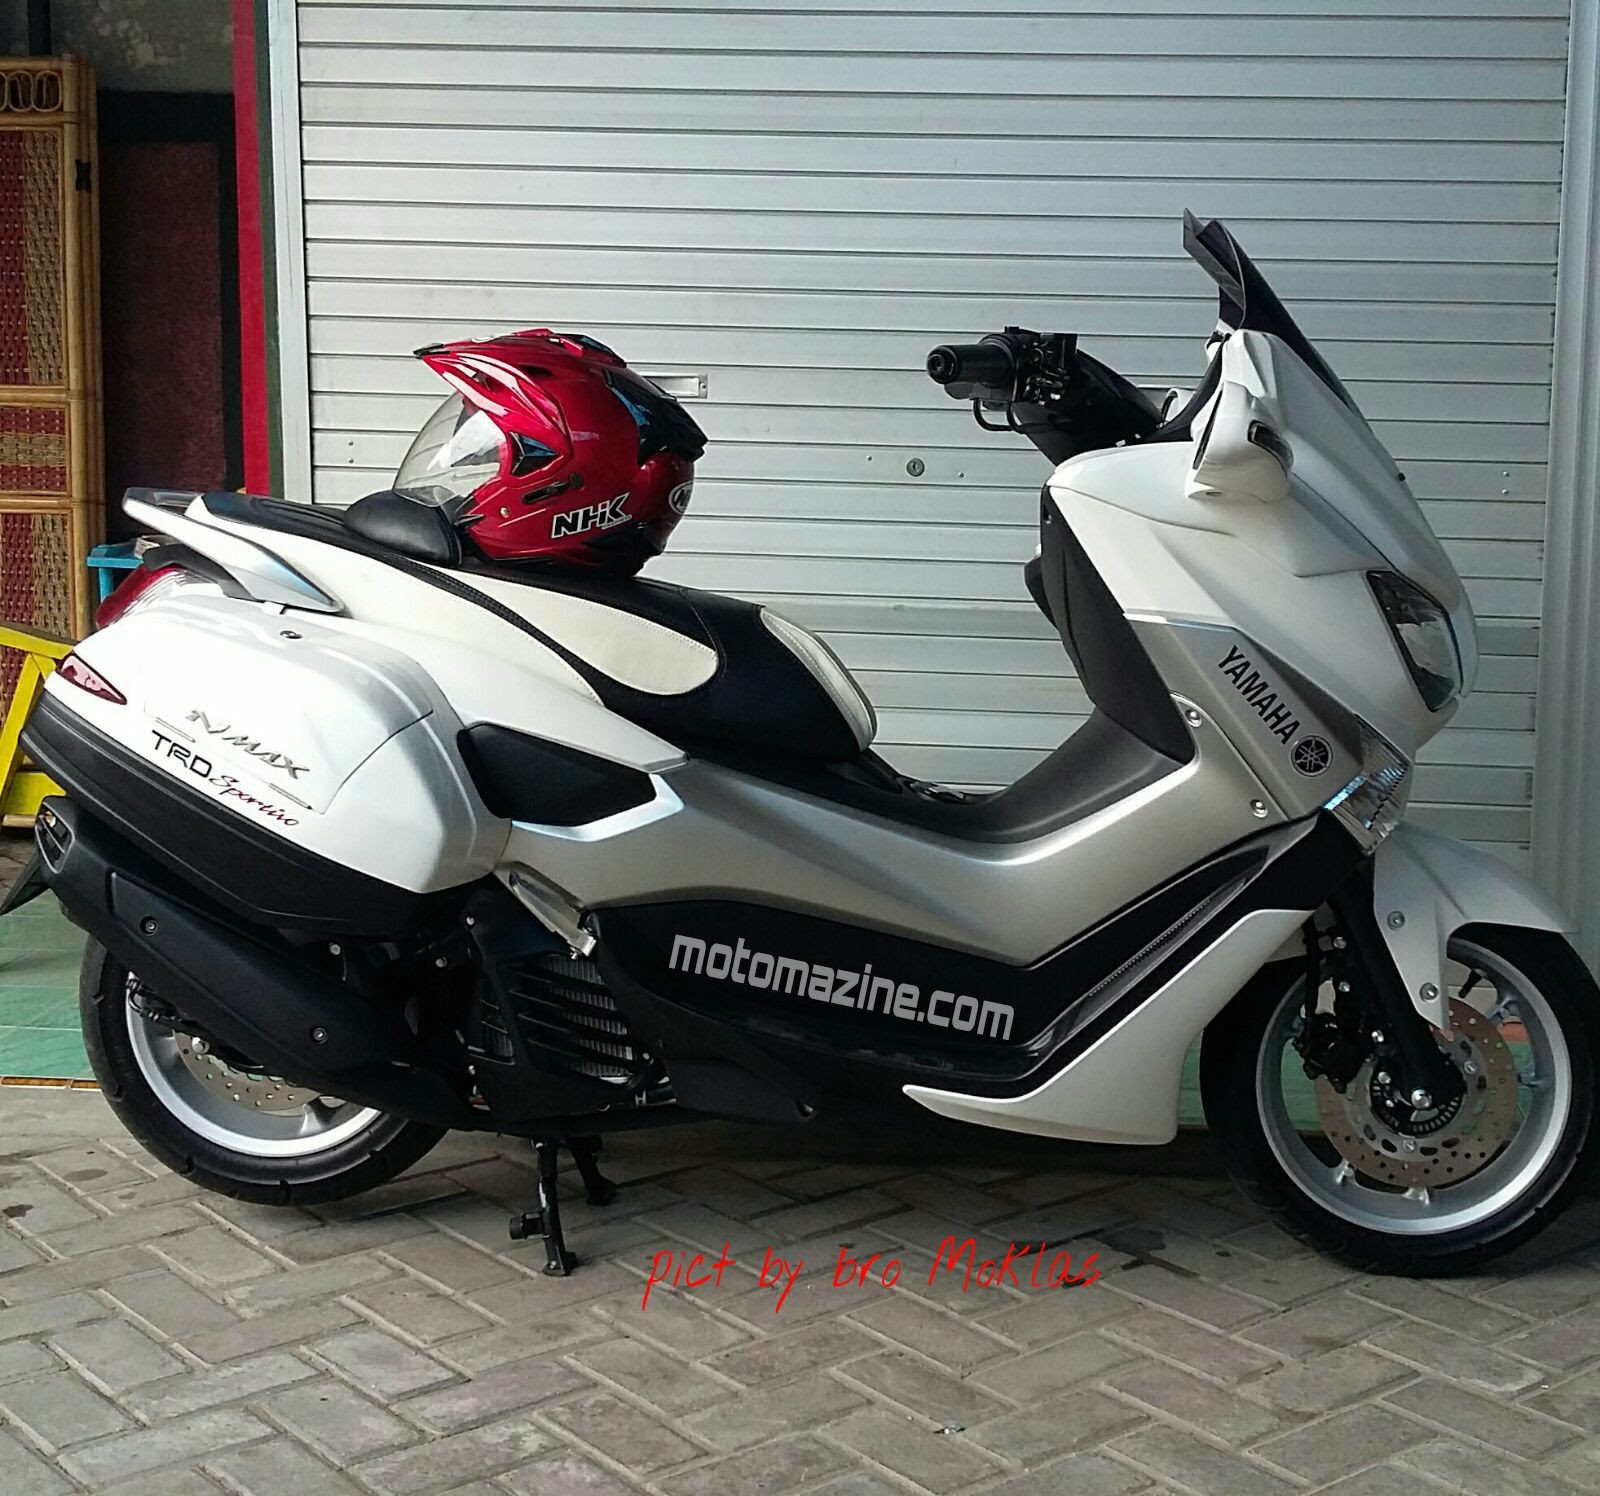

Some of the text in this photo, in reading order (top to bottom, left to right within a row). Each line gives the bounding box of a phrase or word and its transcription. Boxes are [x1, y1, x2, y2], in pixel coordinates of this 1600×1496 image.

[551, 492, 631, 539] NHK
[1218, 644, 1300, 745] YAMAHA
[151, 729, 299, 826] TRD Sportivo
